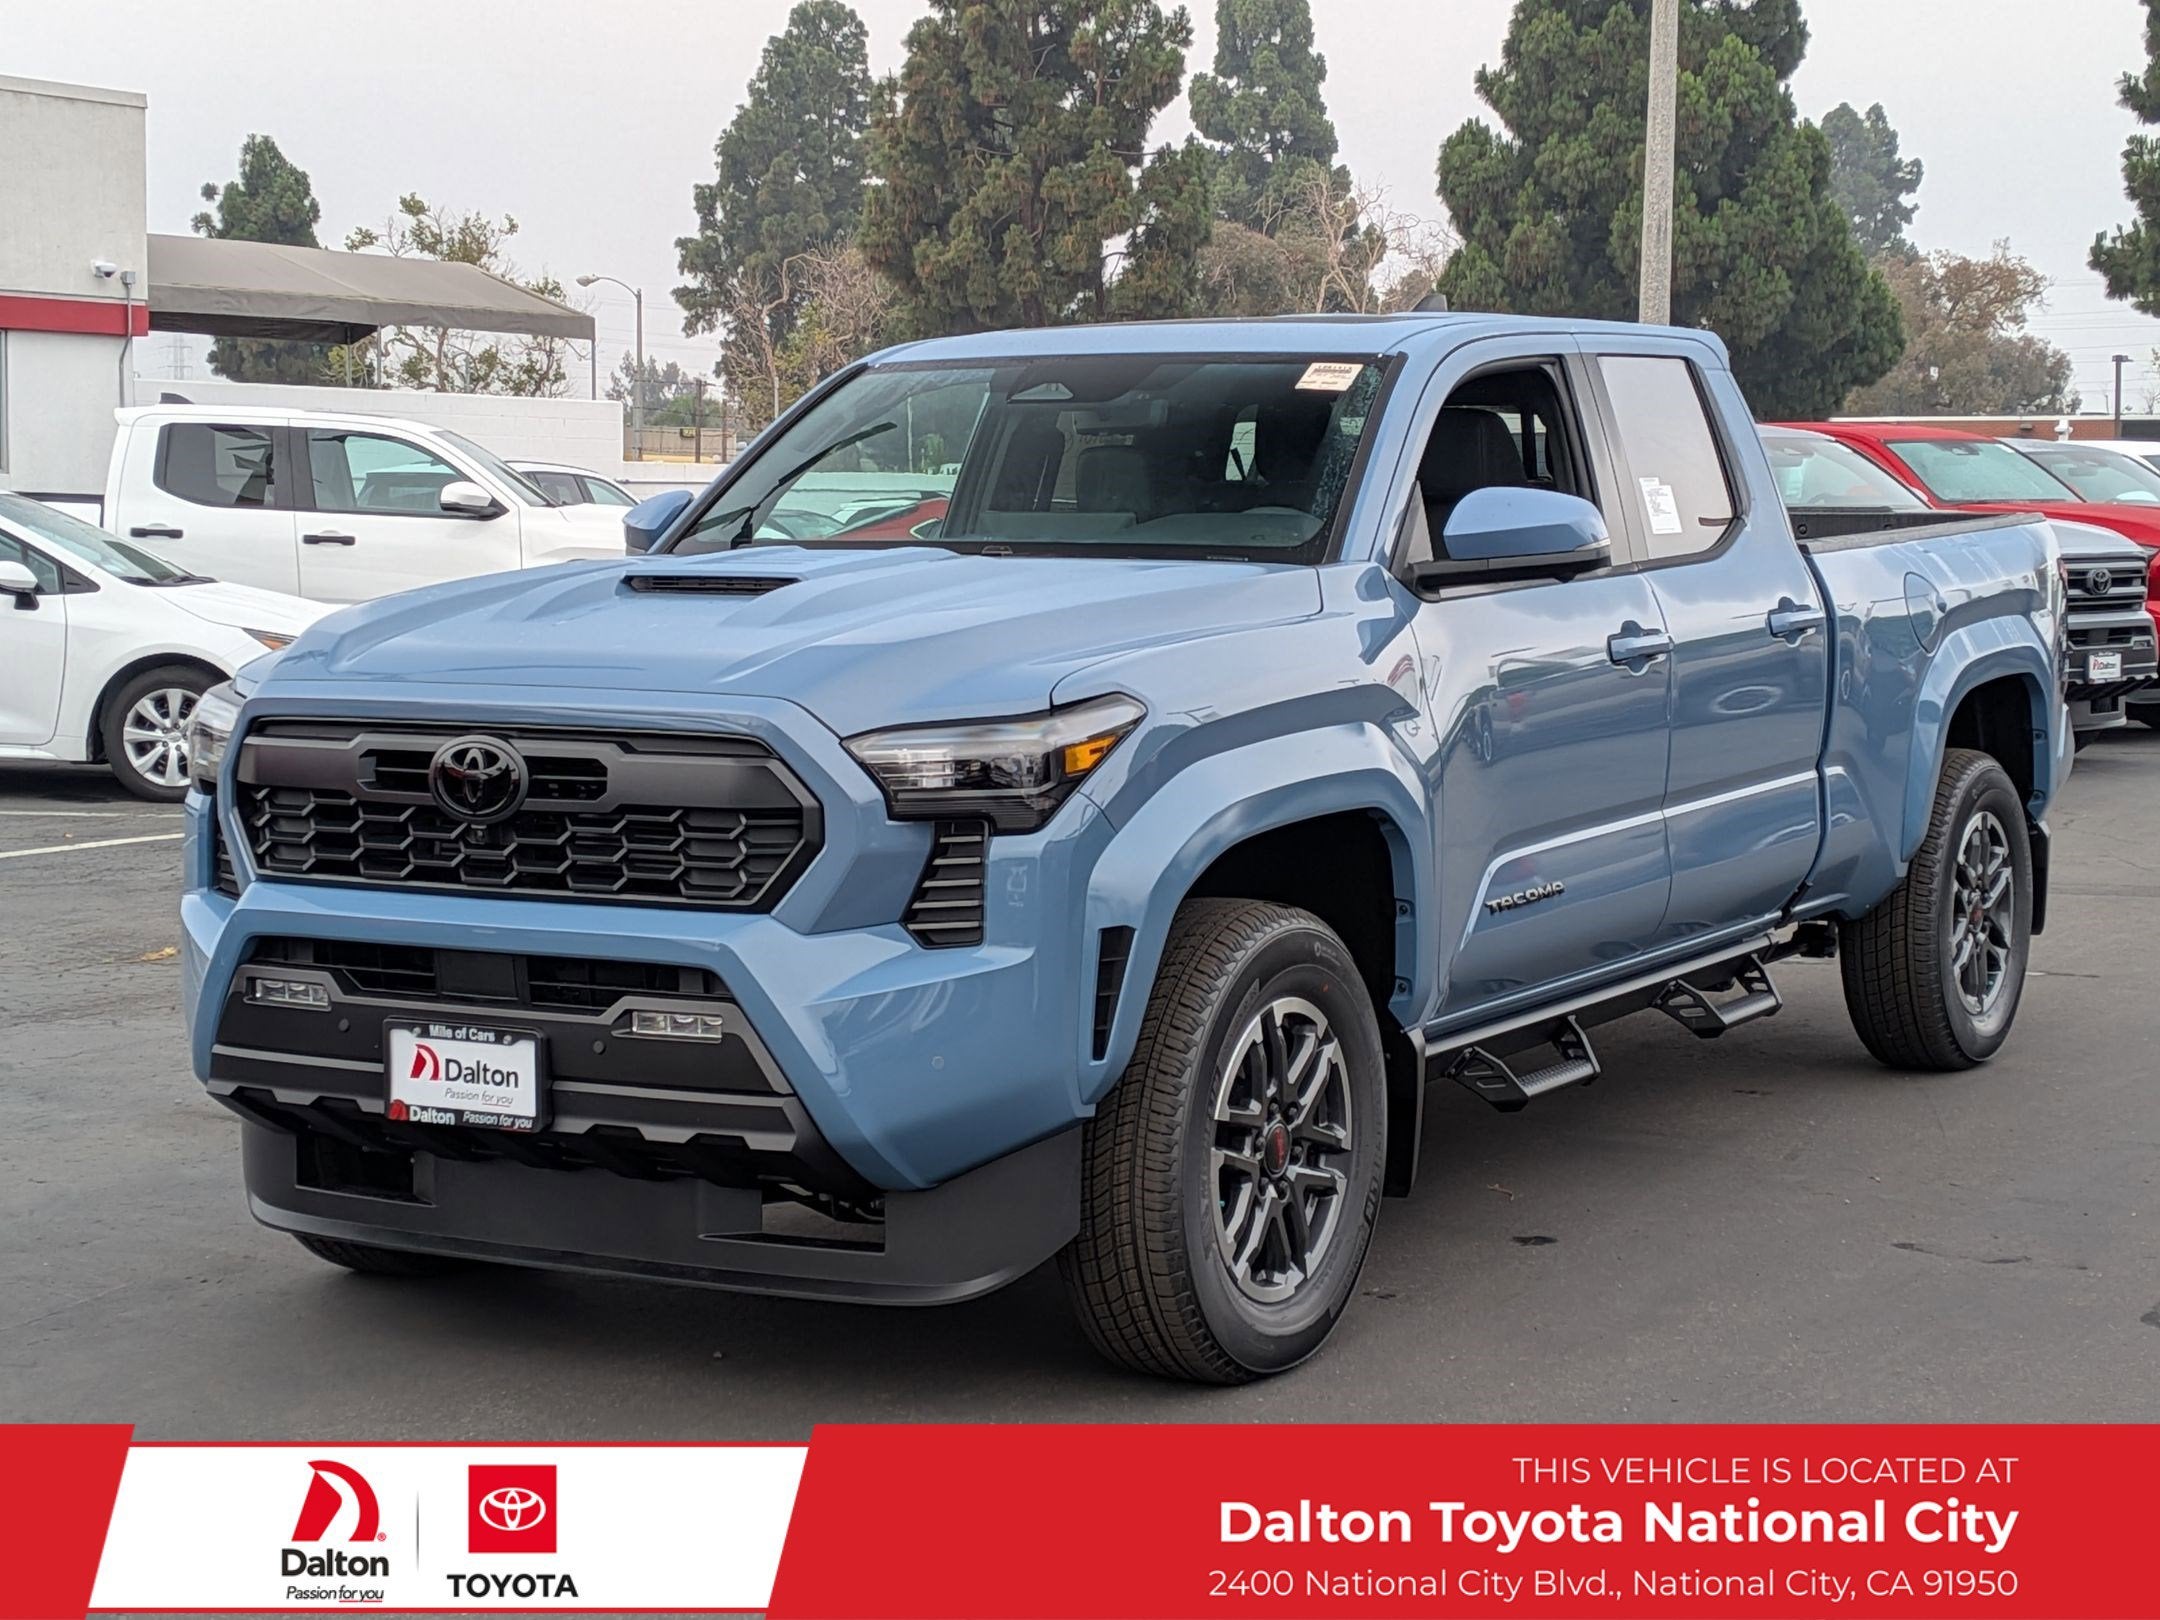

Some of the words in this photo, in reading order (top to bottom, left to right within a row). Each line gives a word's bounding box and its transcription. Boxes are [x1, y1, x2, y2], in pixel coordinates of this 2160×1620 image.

[1485, 881, 1565, 915] TACOMA
[429, 1024, 453, 1038] Mile
[454, 1027, 467, 1039] of
[469, 1028, 496, 1041] Cars
[445, 1058, 519, 1088] Dalton
[445, 1087, 480, 1101] Passion
[481, 1090, 495, 1102] for
[496, 1095, 514, 1105] you
[409, 1106, 456, 1125] Dalton
[463, 1111, 498, 1125] Passion
[499, 1114, 513, 1126] for
[514, 1118, 533, 1129] you
